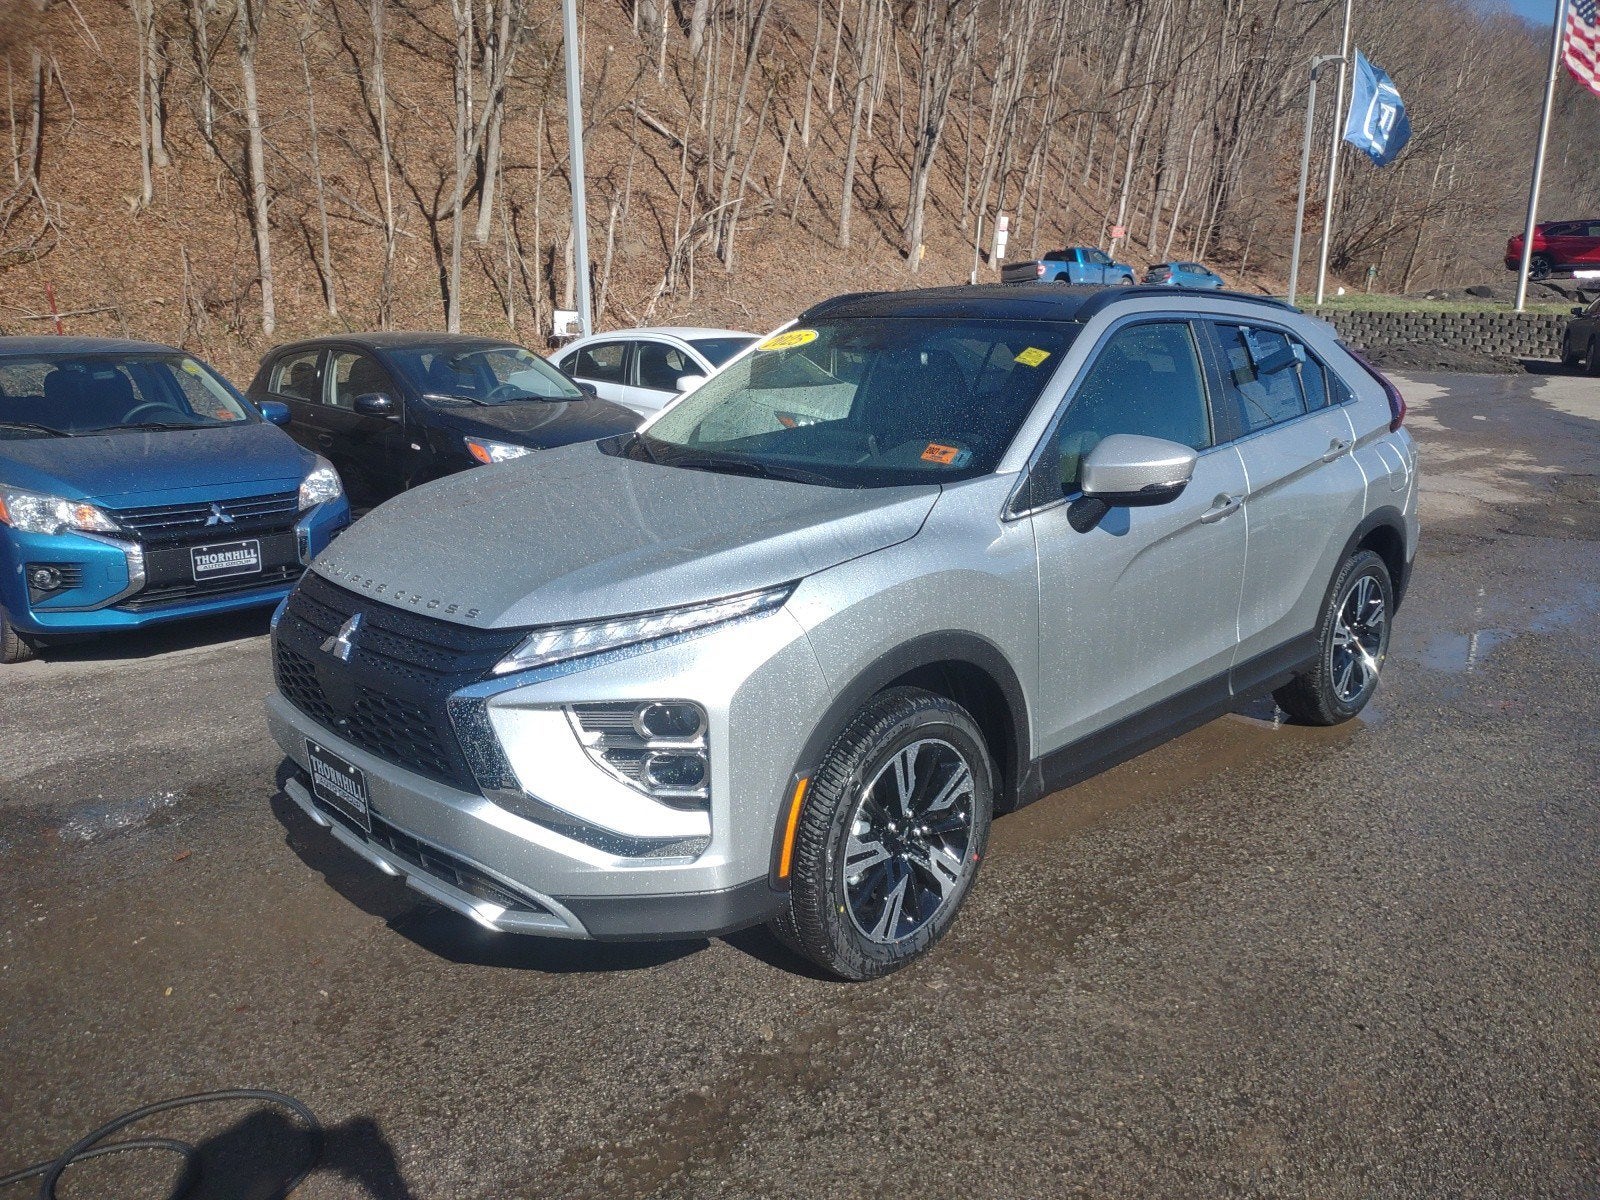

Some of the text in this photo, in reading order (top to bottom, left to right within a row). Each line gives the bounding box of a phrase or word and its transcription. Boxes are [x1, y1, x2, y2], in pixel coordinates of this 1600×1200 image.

[195, 548, 257, 565] THORNHILL
[226, 559, 253, 567] GROUP
[318, 558, 482, 620] ECLIPSE CROSS
[309, 754, 365, 803] THORNHILL
